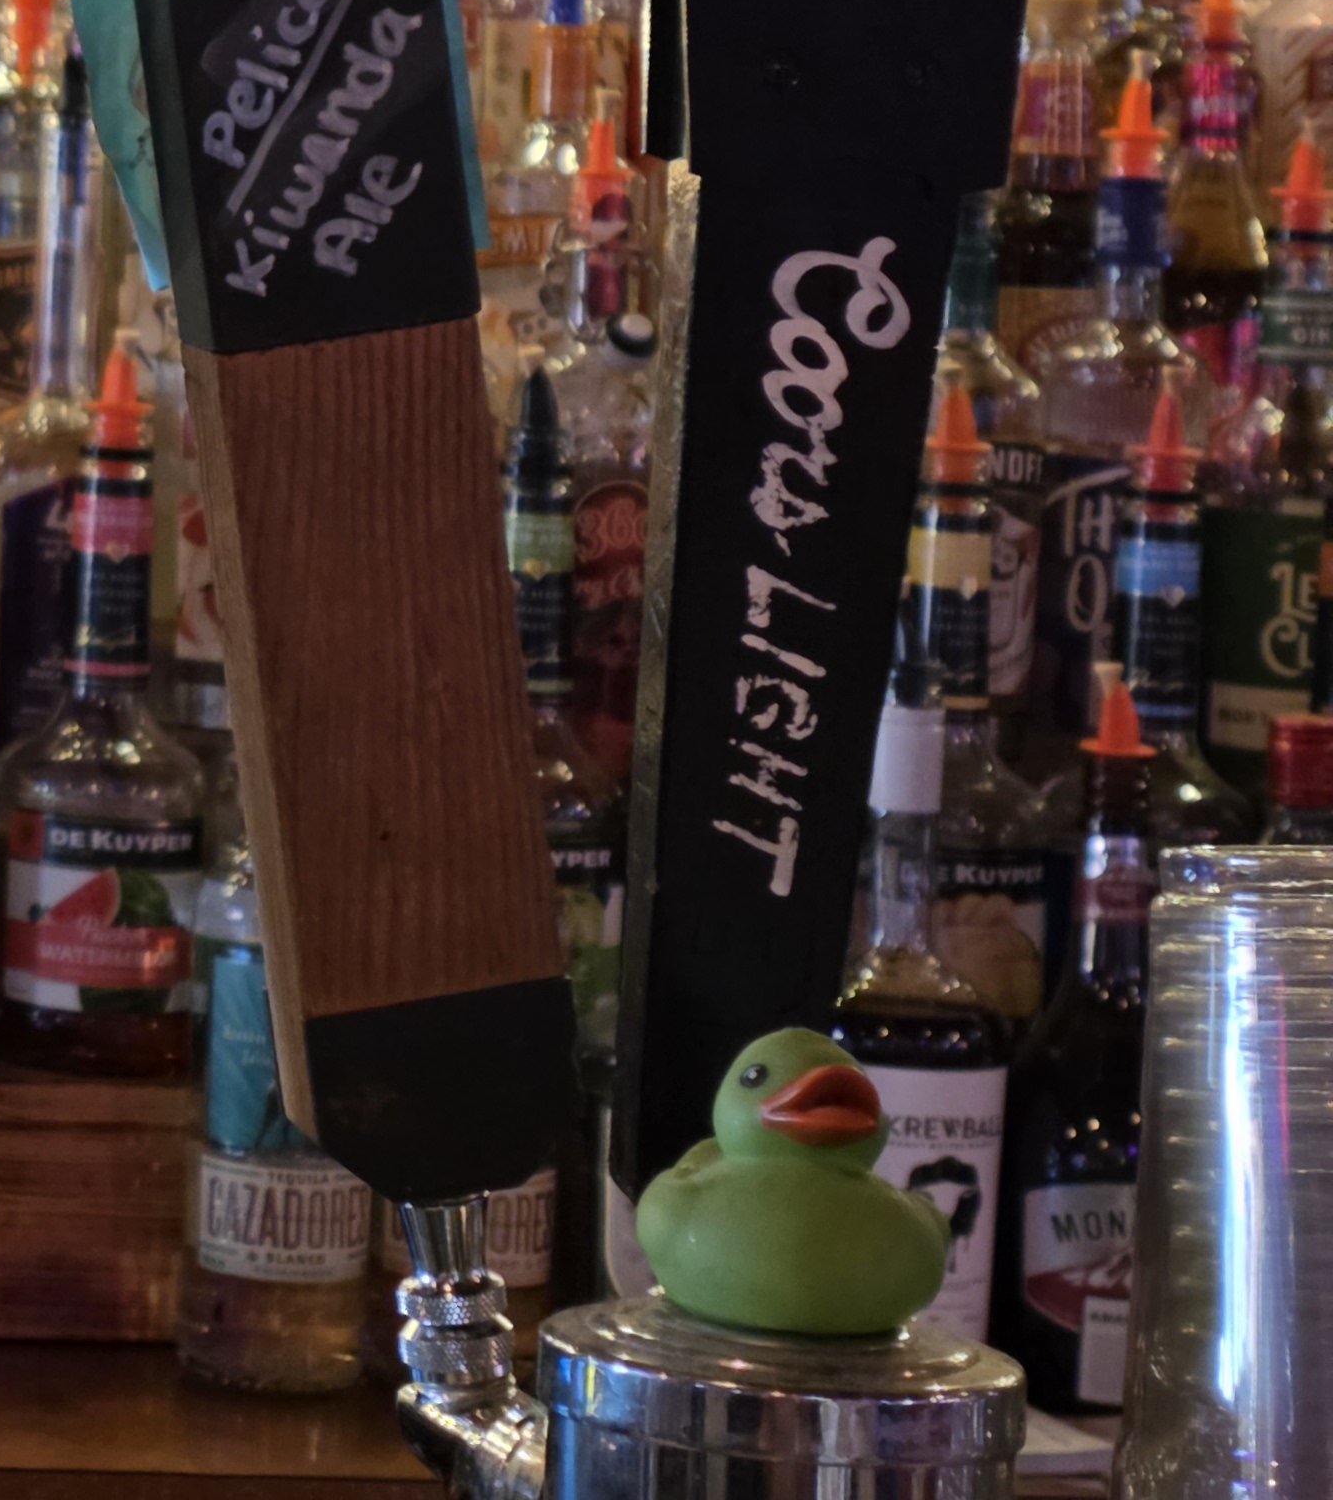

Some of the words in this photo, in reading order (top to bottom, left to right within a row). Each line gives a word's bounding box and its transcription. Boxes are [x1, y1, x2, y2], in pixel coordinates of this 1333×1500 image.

[313, 153, 424, 278] Ale
[749, 235, 912, 532] Coors
[712, 563, 837, 898] LIGHT
[48, 825, 84, 847] DE
[90, 828, 194, 853] KUYPER
[549, 847, 613, 870] YPER
[1050, 1209, 1128, 1243] MON
